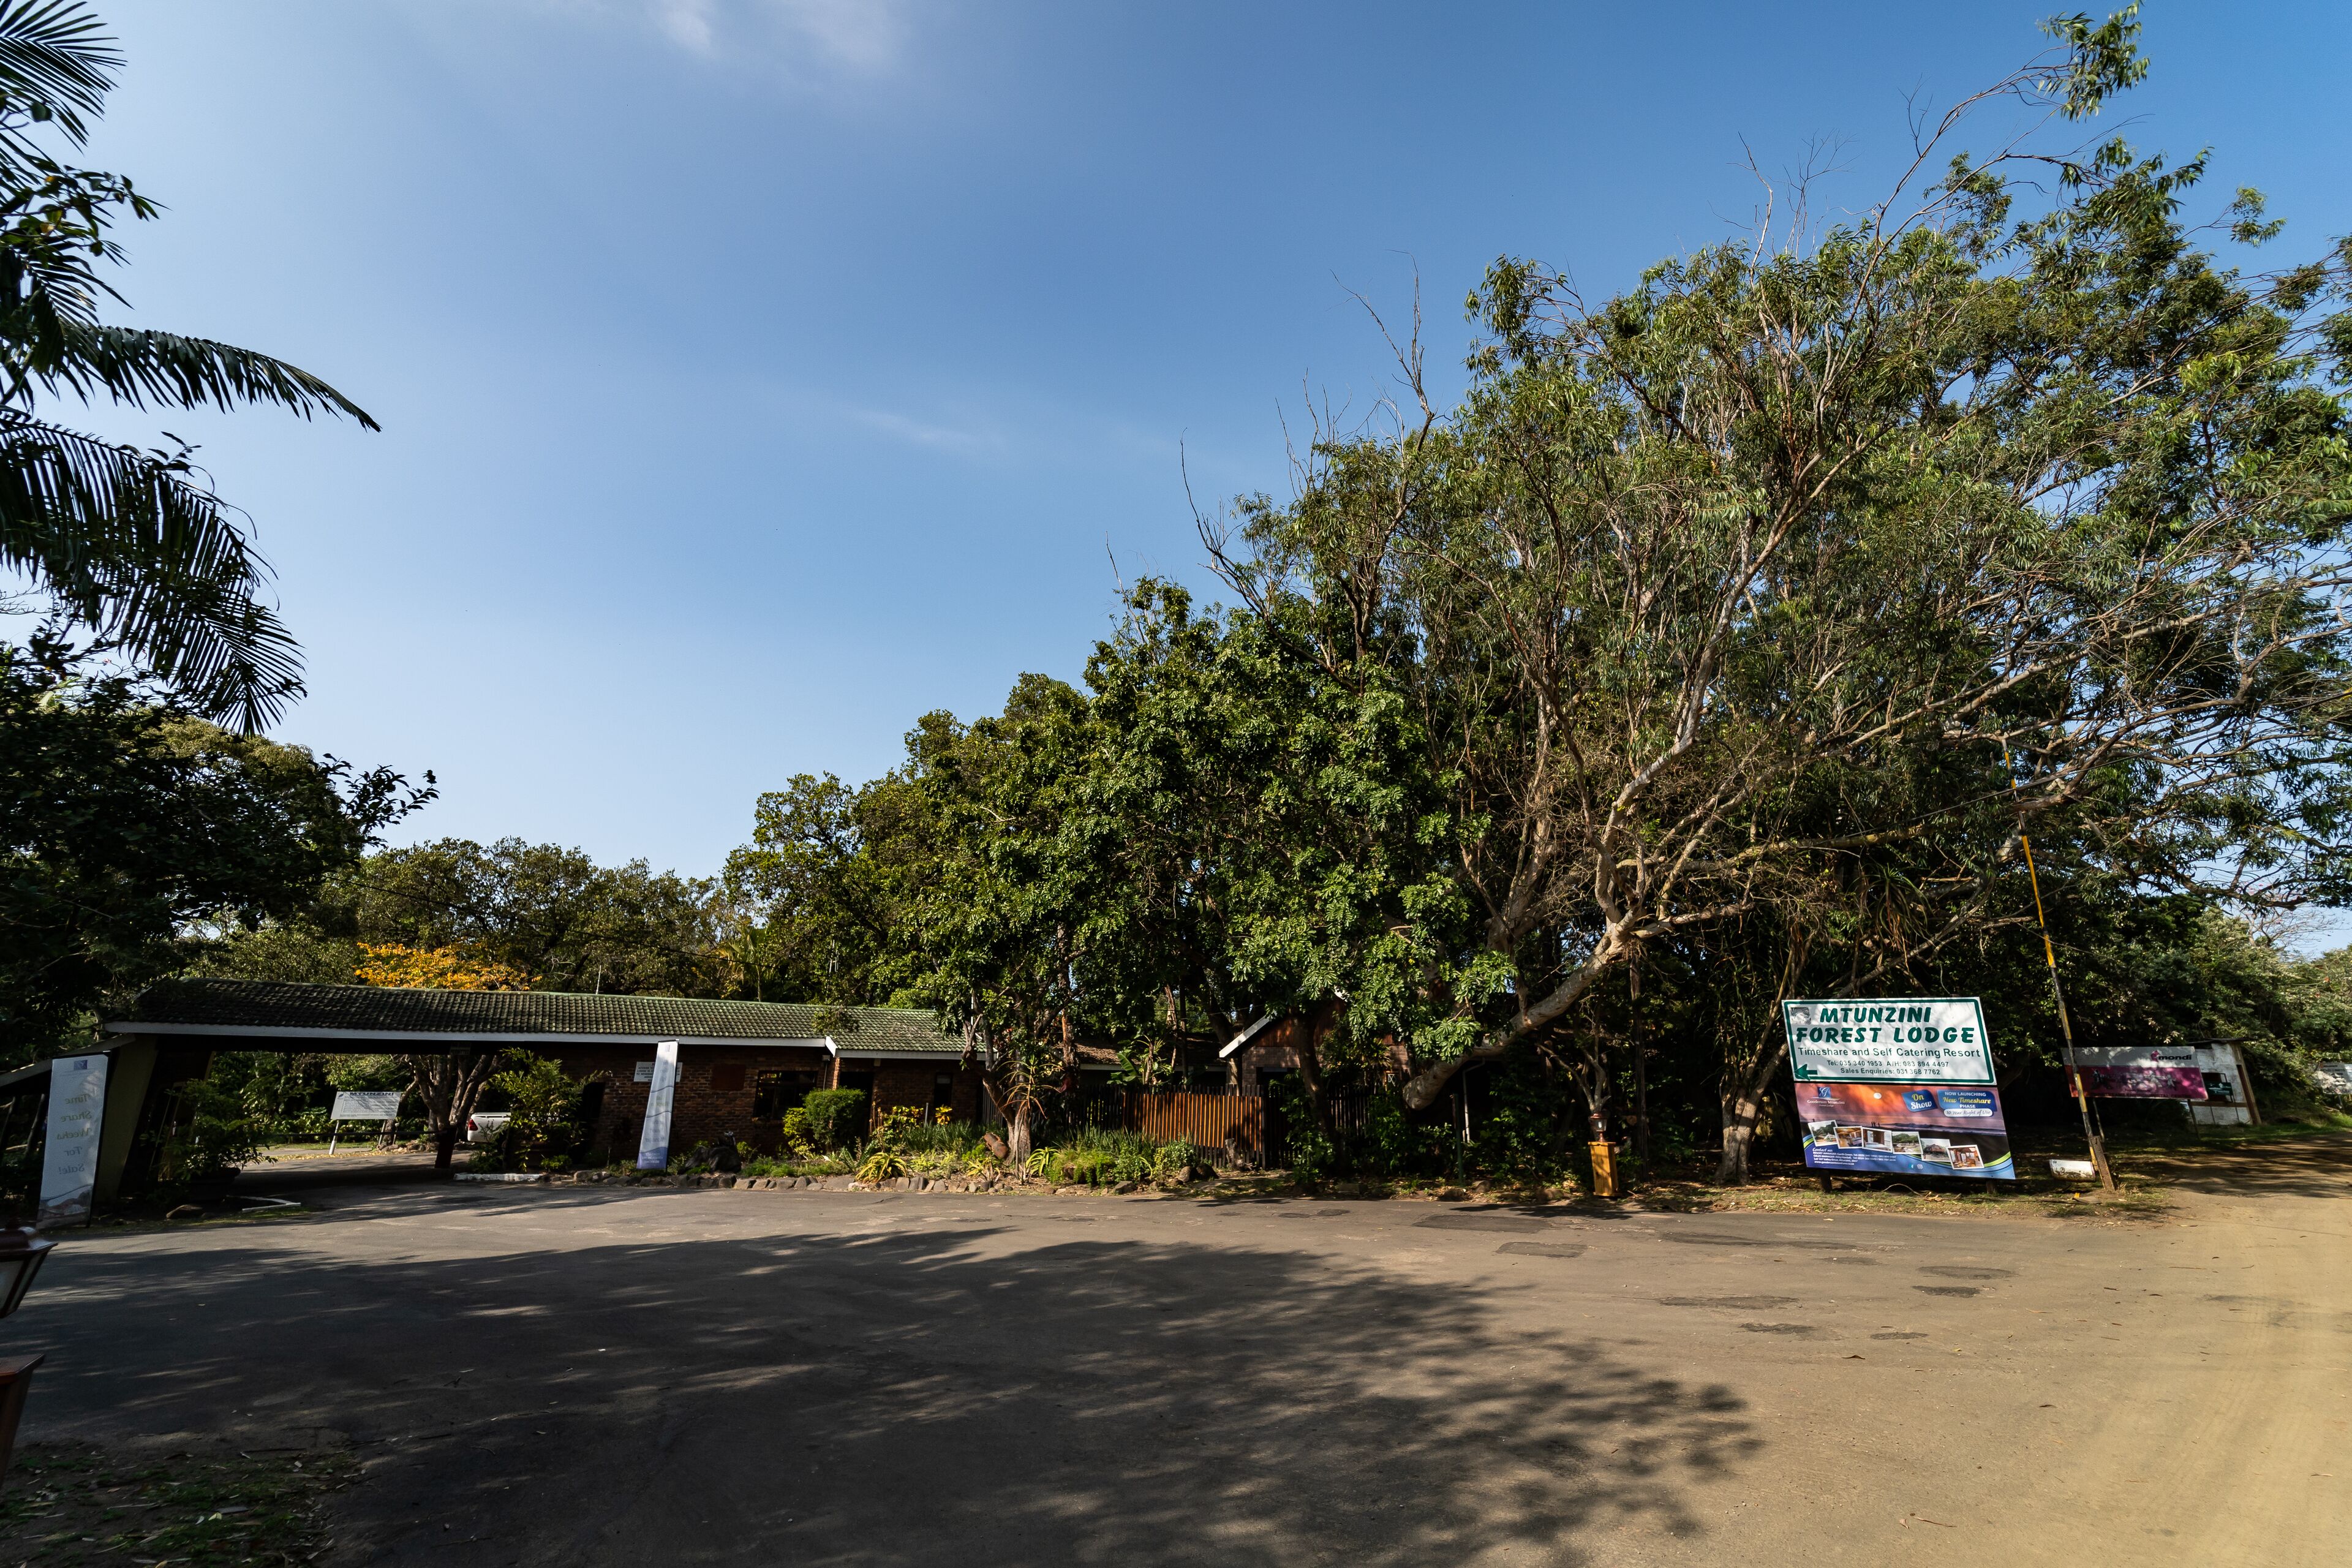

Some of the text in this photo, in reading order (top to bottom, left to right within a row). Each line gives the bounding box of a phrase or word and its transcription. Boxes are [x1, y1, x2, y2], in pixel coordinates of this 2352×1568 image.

[1820, 1007, 1931, 1023] MTUNZINI
[1796, 1027, 1975, 1044] FOREST LODGE
[1798, 1047, 1981, 1061] Timeshare and Self Catering Resort
[1912, 1093, 1924, 1101] On
[1911, 1101, 1932, 1110] Show
